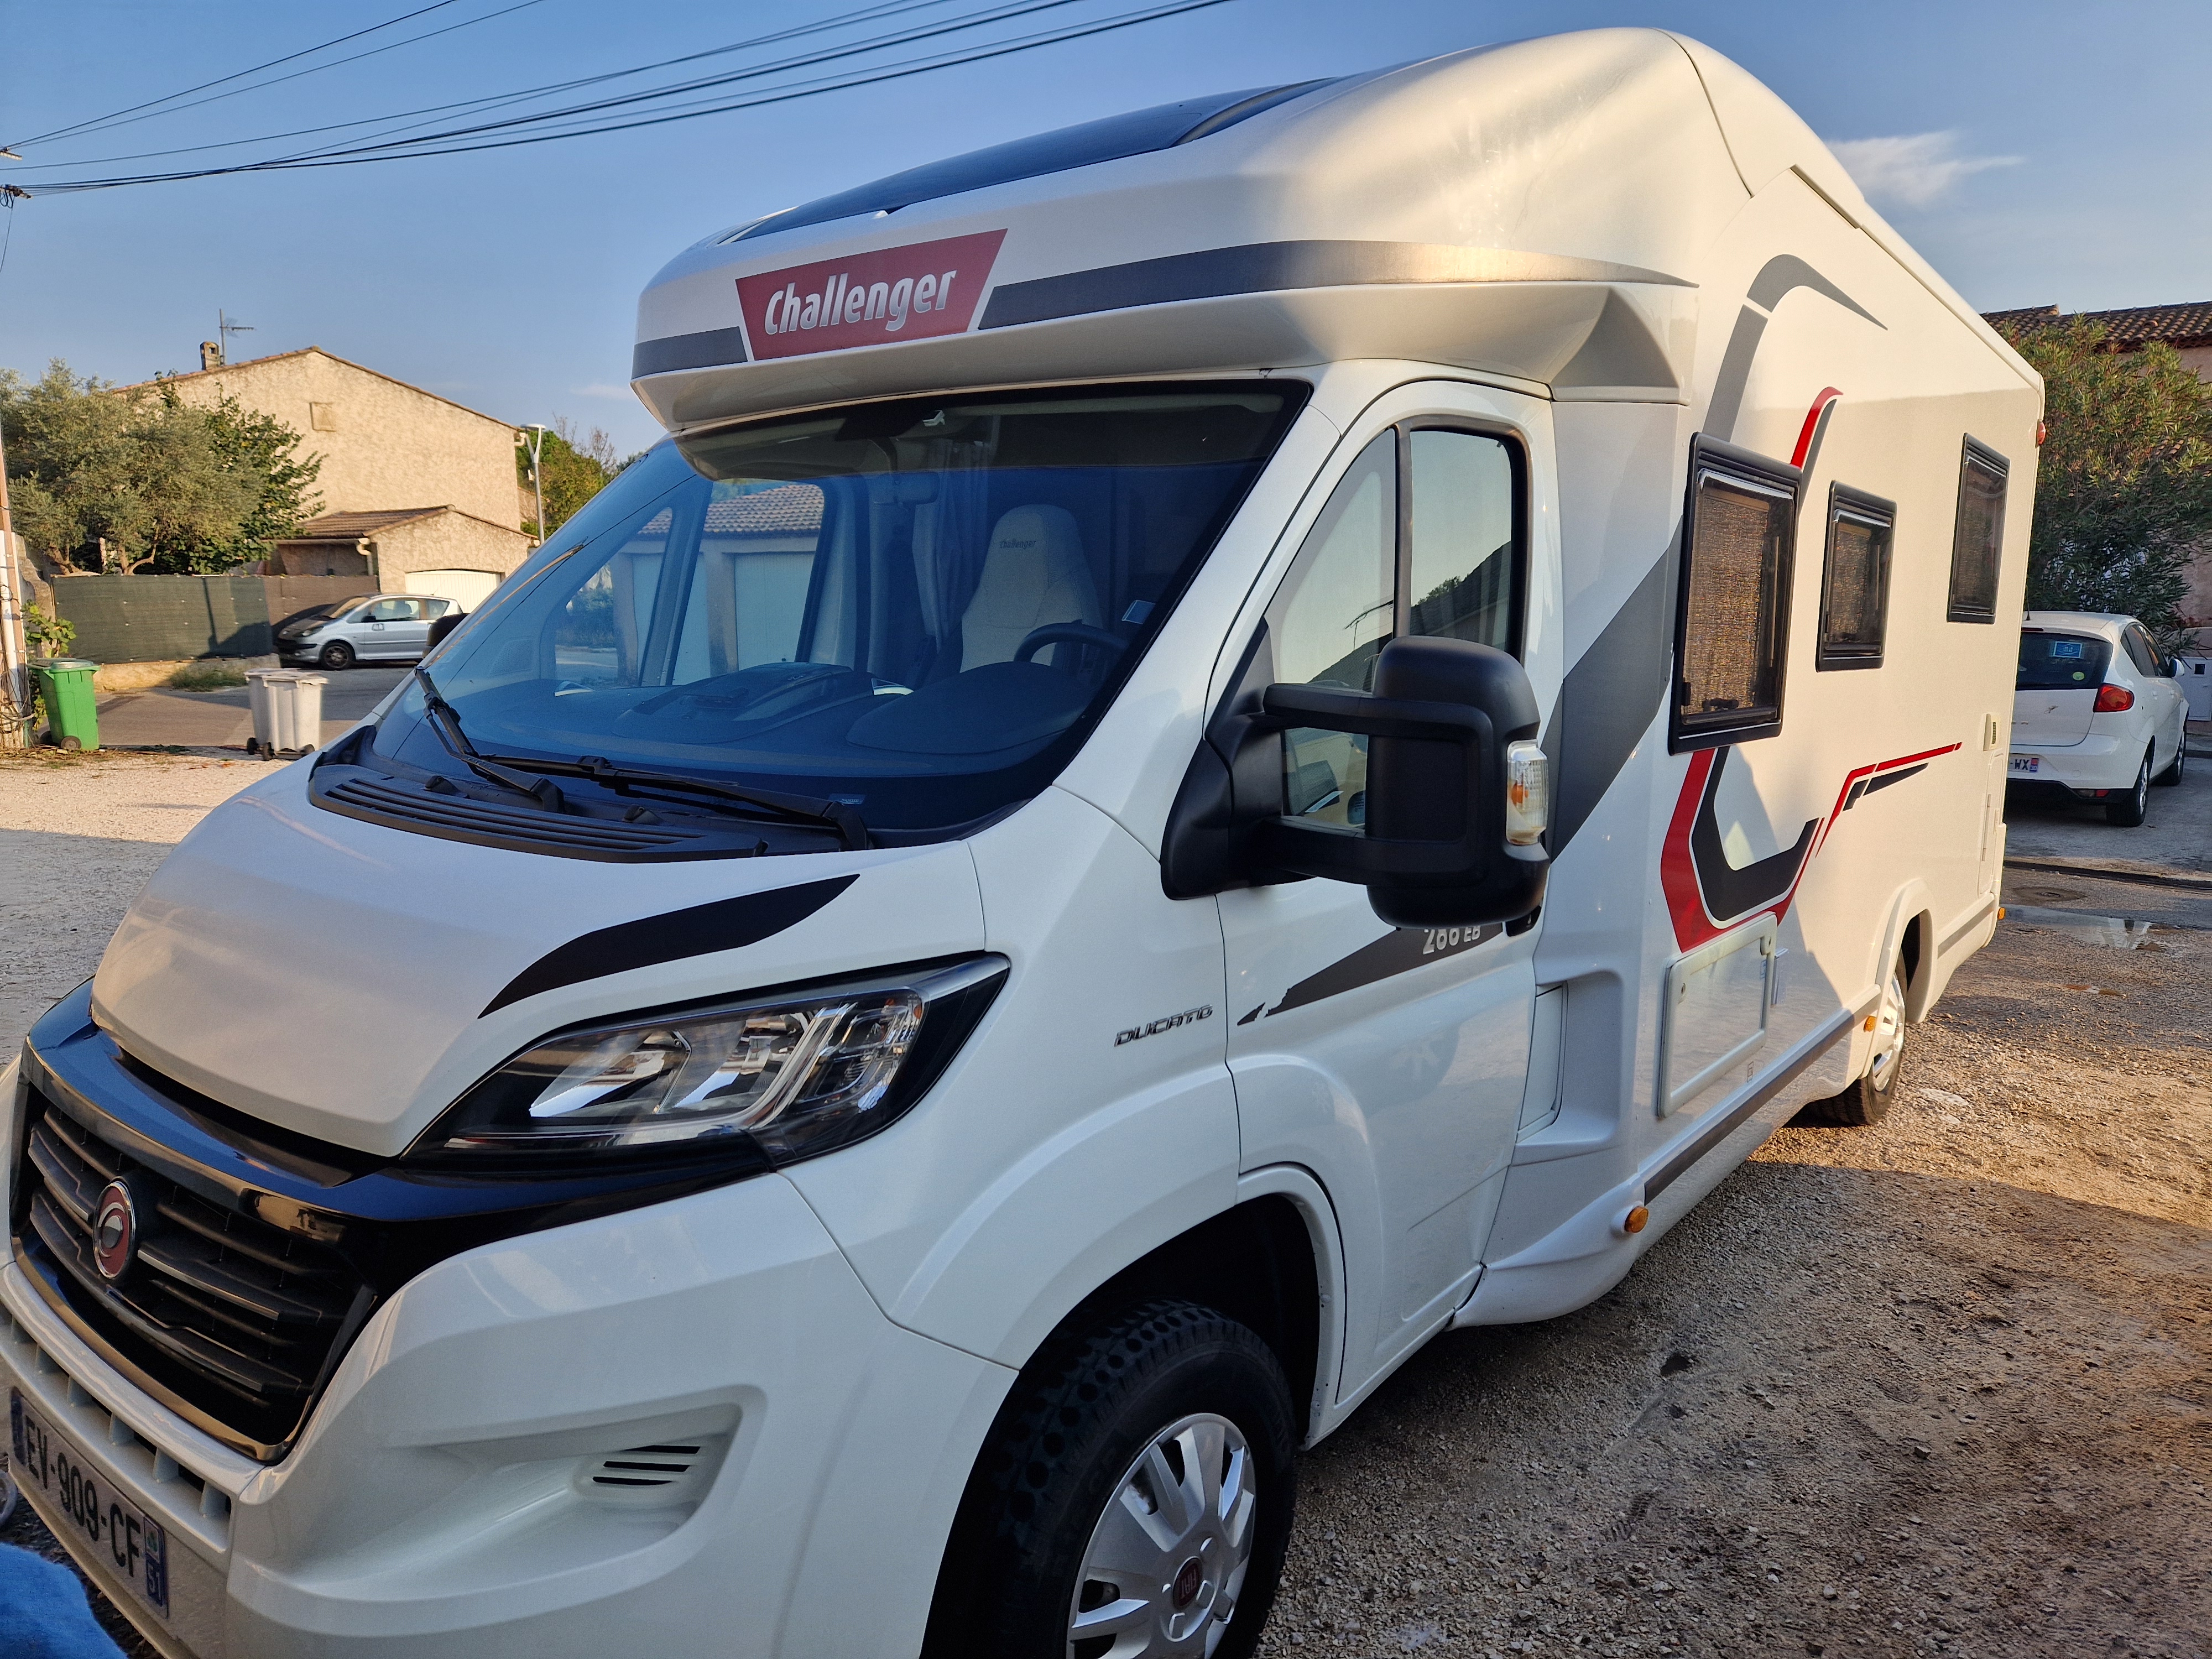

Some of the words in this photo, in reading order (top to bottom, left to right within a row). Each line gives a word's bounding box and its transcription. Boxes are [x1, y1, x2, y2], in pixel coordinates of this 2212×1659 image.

[764, 269, 957, 335] Challenger
[1114, 1004, 1213, 1047] DUCATO
[25, 1415, 141, 1578] EV-909-CF
[1181, 1568, 1197, 1599] FIAT
